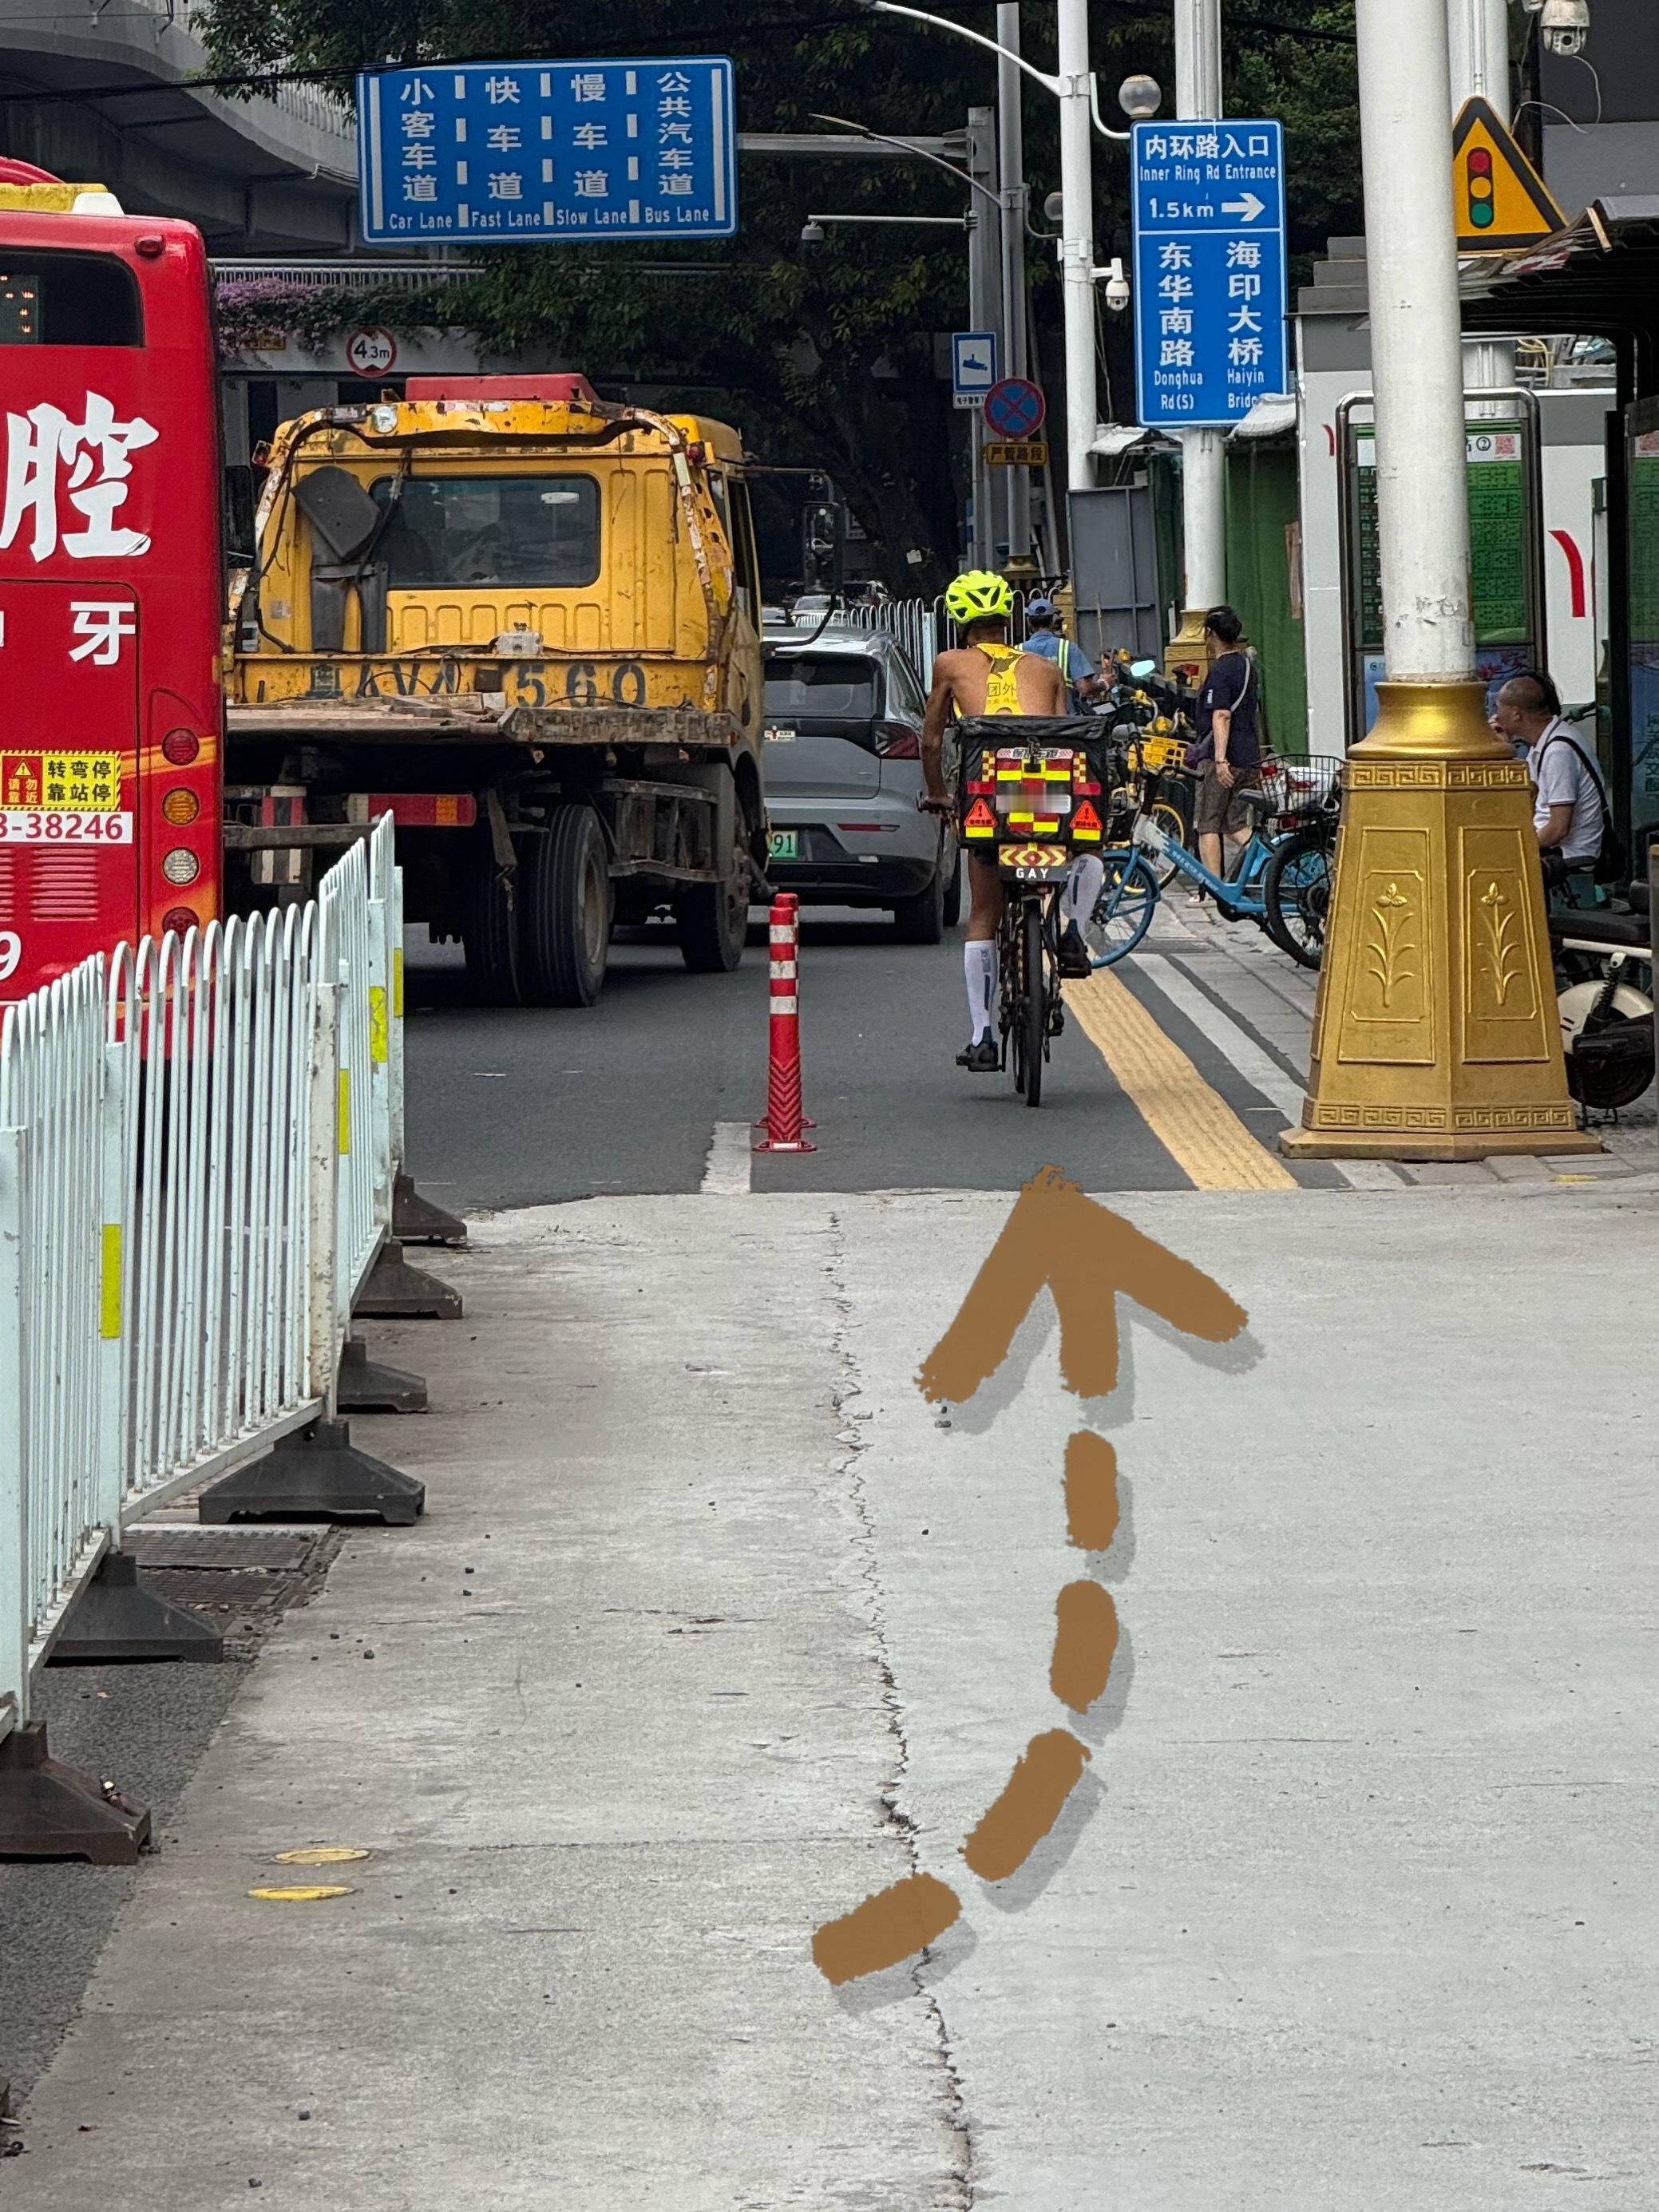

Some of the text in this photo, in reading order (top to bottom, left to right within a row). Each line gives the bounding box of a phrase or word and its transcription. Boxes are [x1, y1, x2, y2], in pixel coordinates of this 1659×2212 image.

[400, 78, 438, 202] 小客车道
[485, 76, 523, 200] 快车道
[570, 73, 608, 198] 慢车道
[656, 71, 694, 196] 公共汽车道
[1146, 134, 1269, 160] 内环路入口
[1140, 165, 1277, 184] Inner Ring Rd Entrance
[556, 208, 627, 225] Slow Lane
[644, 207, 710, 224] Bus Lane
[1150, 197, 1214, 219] 1.5km
[389, 212, 452, 229] Car Lane
[472, 211, 540, 228] Fast Lane
[1158, 242, 1196, 367] 东华南路
[1225, 240, 1263, 366] 海印大桥
[354, 339, 390, 358] 4.3m
[1154, 370, 1203, 390] Donghua
[1227, 368, 1265, 387] Haiyin
[1161, 394, 1194, 410] Rd(S)
[1228, 392, 1258, 409] Brid
[991, 447, 1043, 461] 严管路段
[0, 390, 160, 563] 腔
[69, 601, 136, 665] 牙
[47, 760, 111, 779] 转弯停
[8, 778, 38, 790] 请勿
[47, 783, 111, 801] 靠站停
[1016, 868, 1049, 879] GAY
